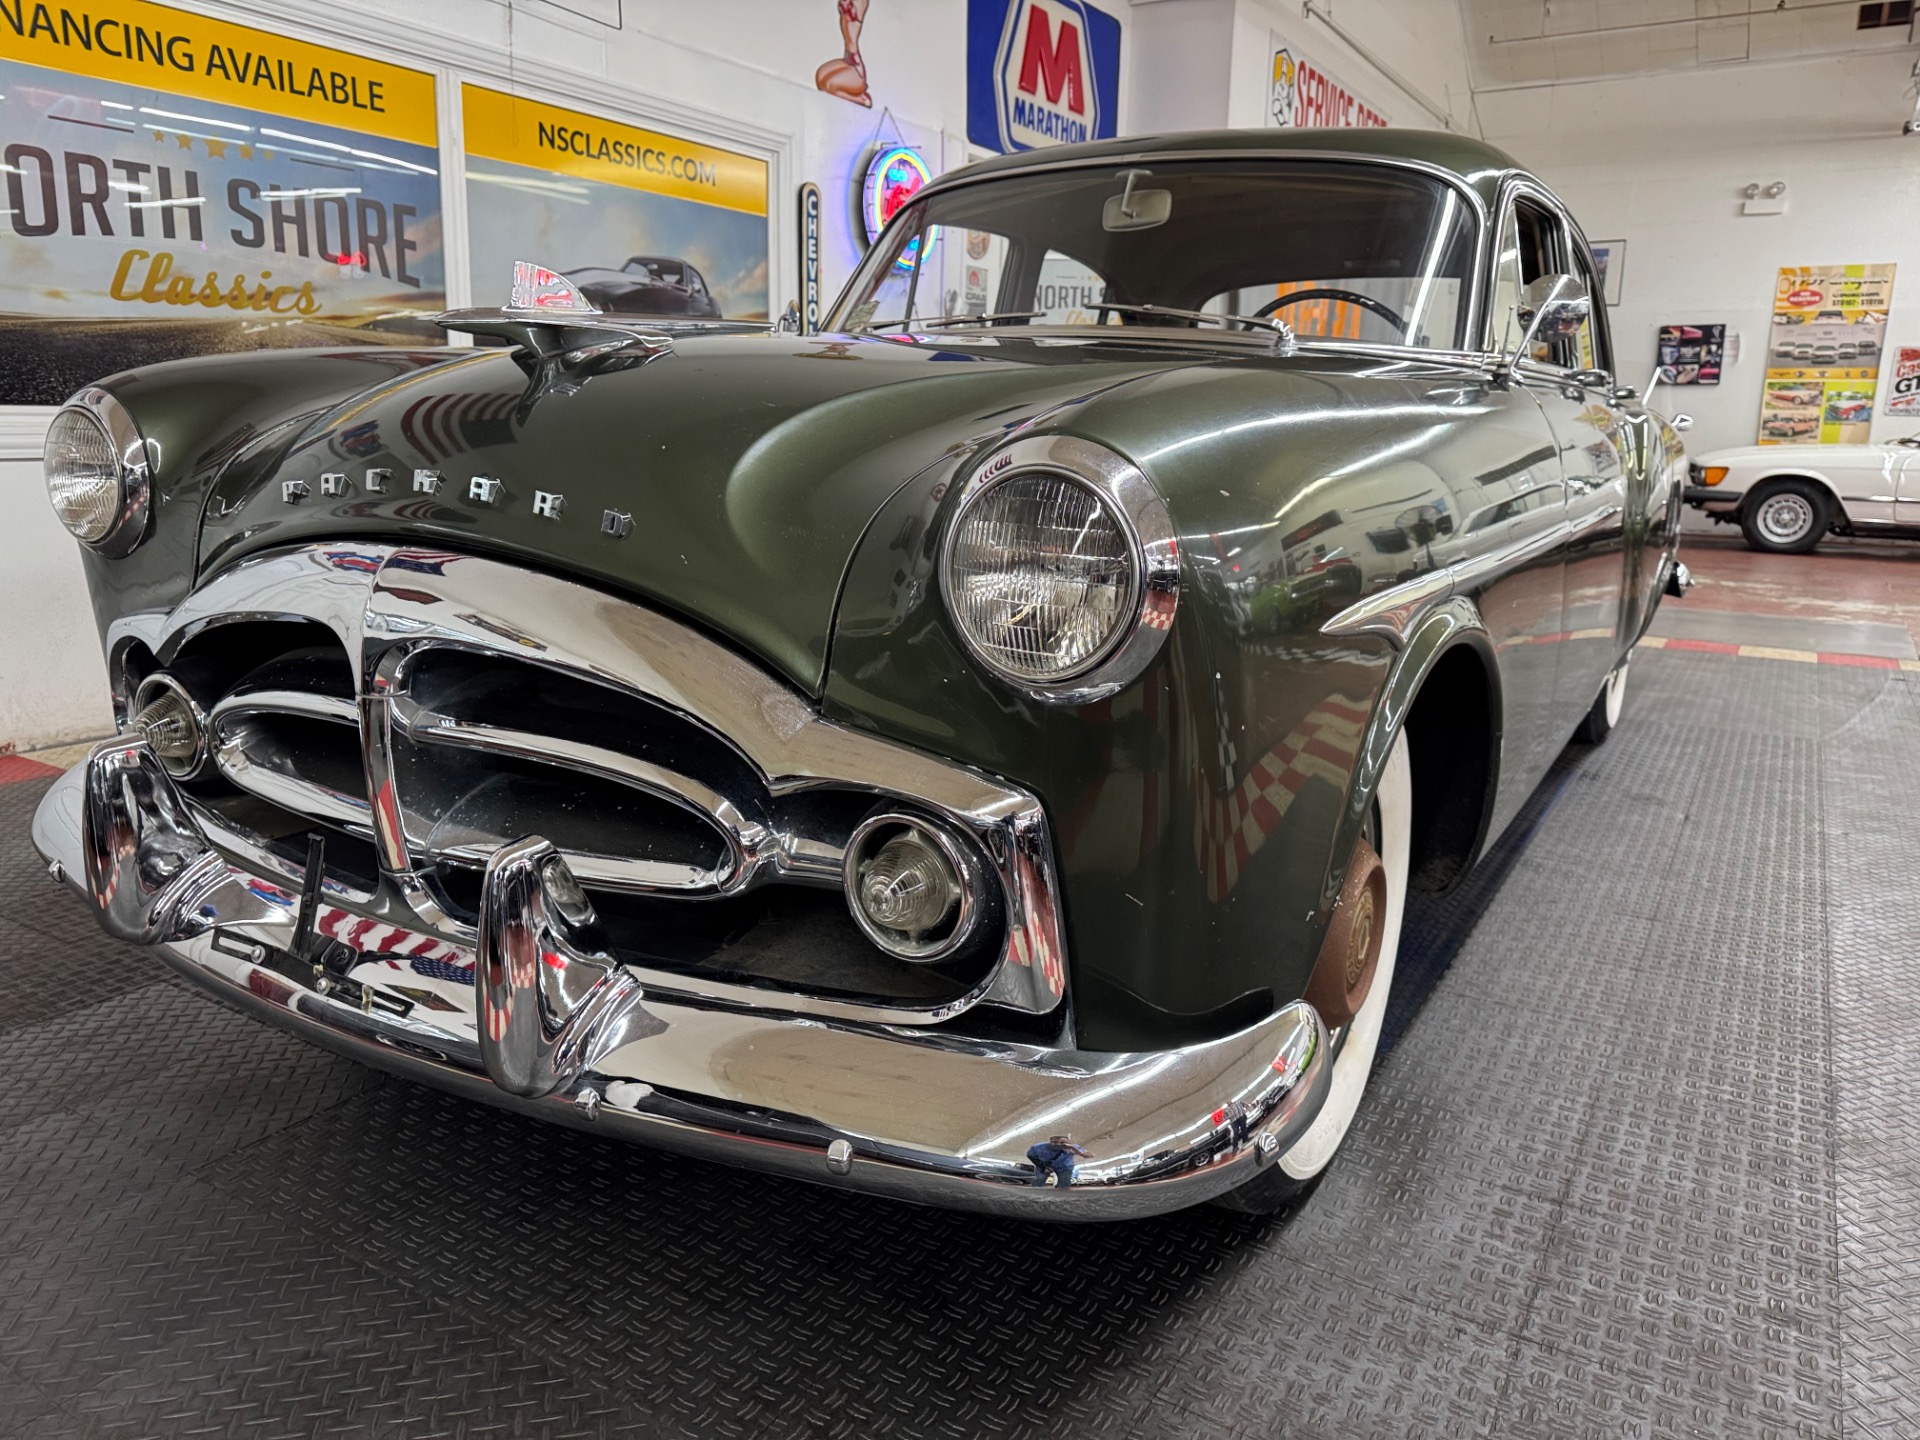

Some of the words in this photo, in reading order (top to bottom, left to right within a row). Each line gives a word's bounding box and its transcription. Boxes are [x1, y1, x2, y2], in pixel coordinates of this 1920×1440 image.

[205, 43, 386, 113] AVAILABLE
[1018, 3, 1085, 117] M
[538, 120, 717, 187] NSCLASSICS.COM
[1013, 96, 1087, 144] MARATHON
[227, 178, 420, 289] SHORE
[109, 248, 322, 315] Classics
[281, 468, 637, 540] PACKARD
